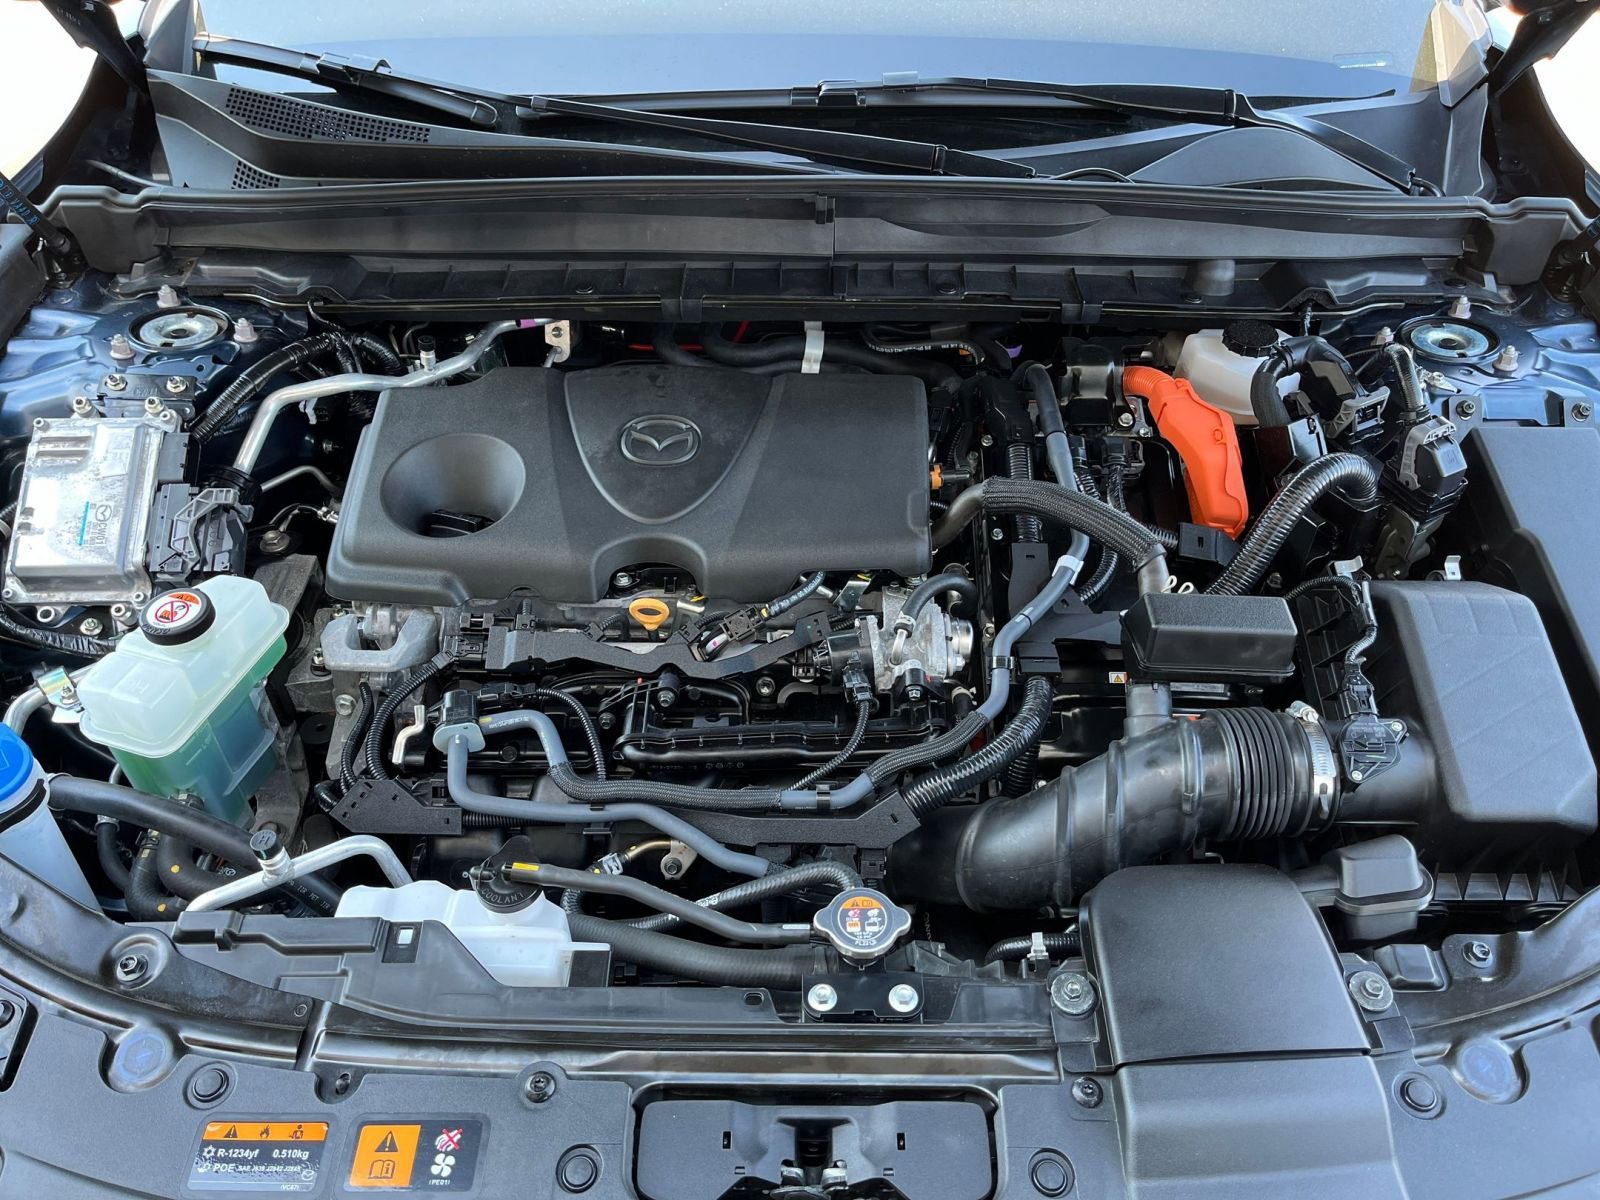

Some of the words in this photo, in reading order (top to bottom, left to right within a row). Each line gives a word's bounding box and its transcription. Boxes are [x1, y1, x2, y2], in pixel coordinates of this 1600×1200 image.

[481, 887, 525, 903] COOLANT
[217, 1148, 260, 1159] R-1234yf
[272, 1149, 310, 1161] 0.510kg
[212, 1163, 235, 1173] POE
